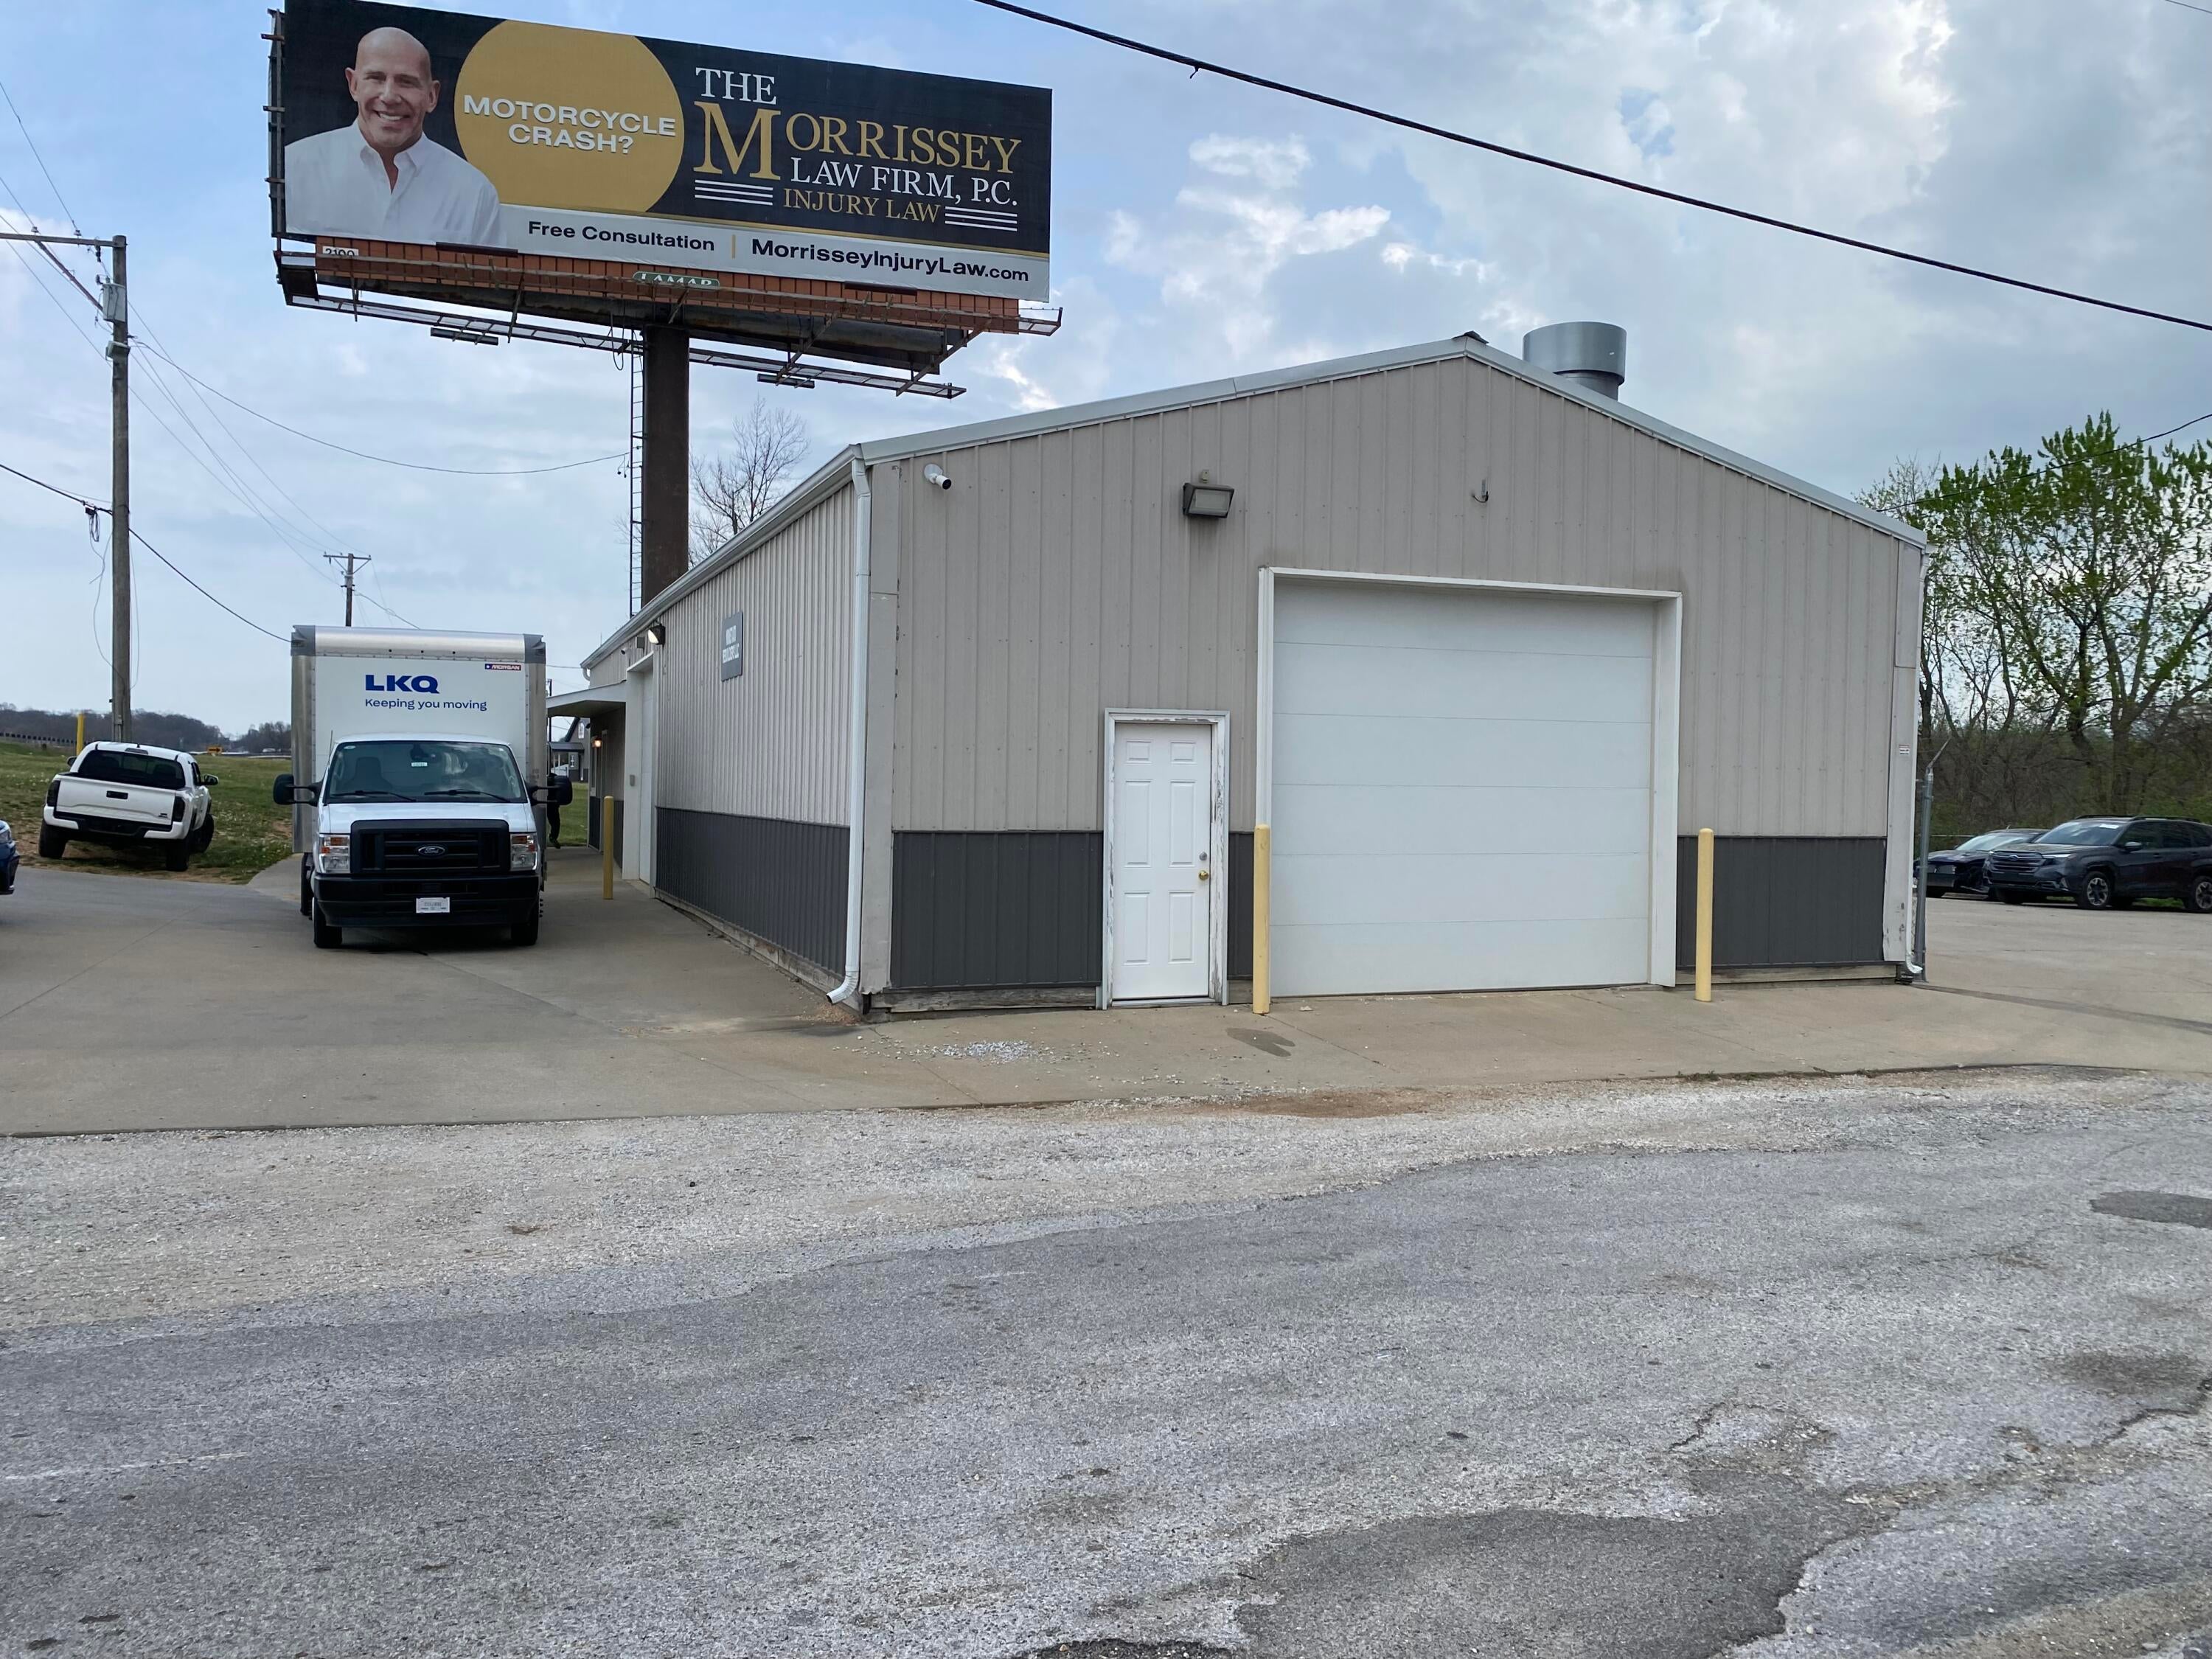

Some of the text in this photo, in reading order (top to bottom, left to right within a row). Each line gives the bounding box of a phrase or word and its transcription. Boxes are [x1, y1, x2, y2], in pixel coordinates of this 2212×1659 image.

[695, 67, 777, 105] THE
[463, 95, 676, 138] MOTORCYCLE
[508, 123, 634, 155] CRASH?
[693, 101, 1022, 181] MORRISSEY
[790, 157, 1018, 206] LAW FIRM, P.C.
[783, 189, 941, 223] INJURY LAW
[529, 221, 714, 251] Free Consultation
[751, 238, 1029, 282] MorrisseyInjuryLaw.com
[365, 674, 440, 694] LKQ
[365, 698, 487, 712] Keeping you moving
